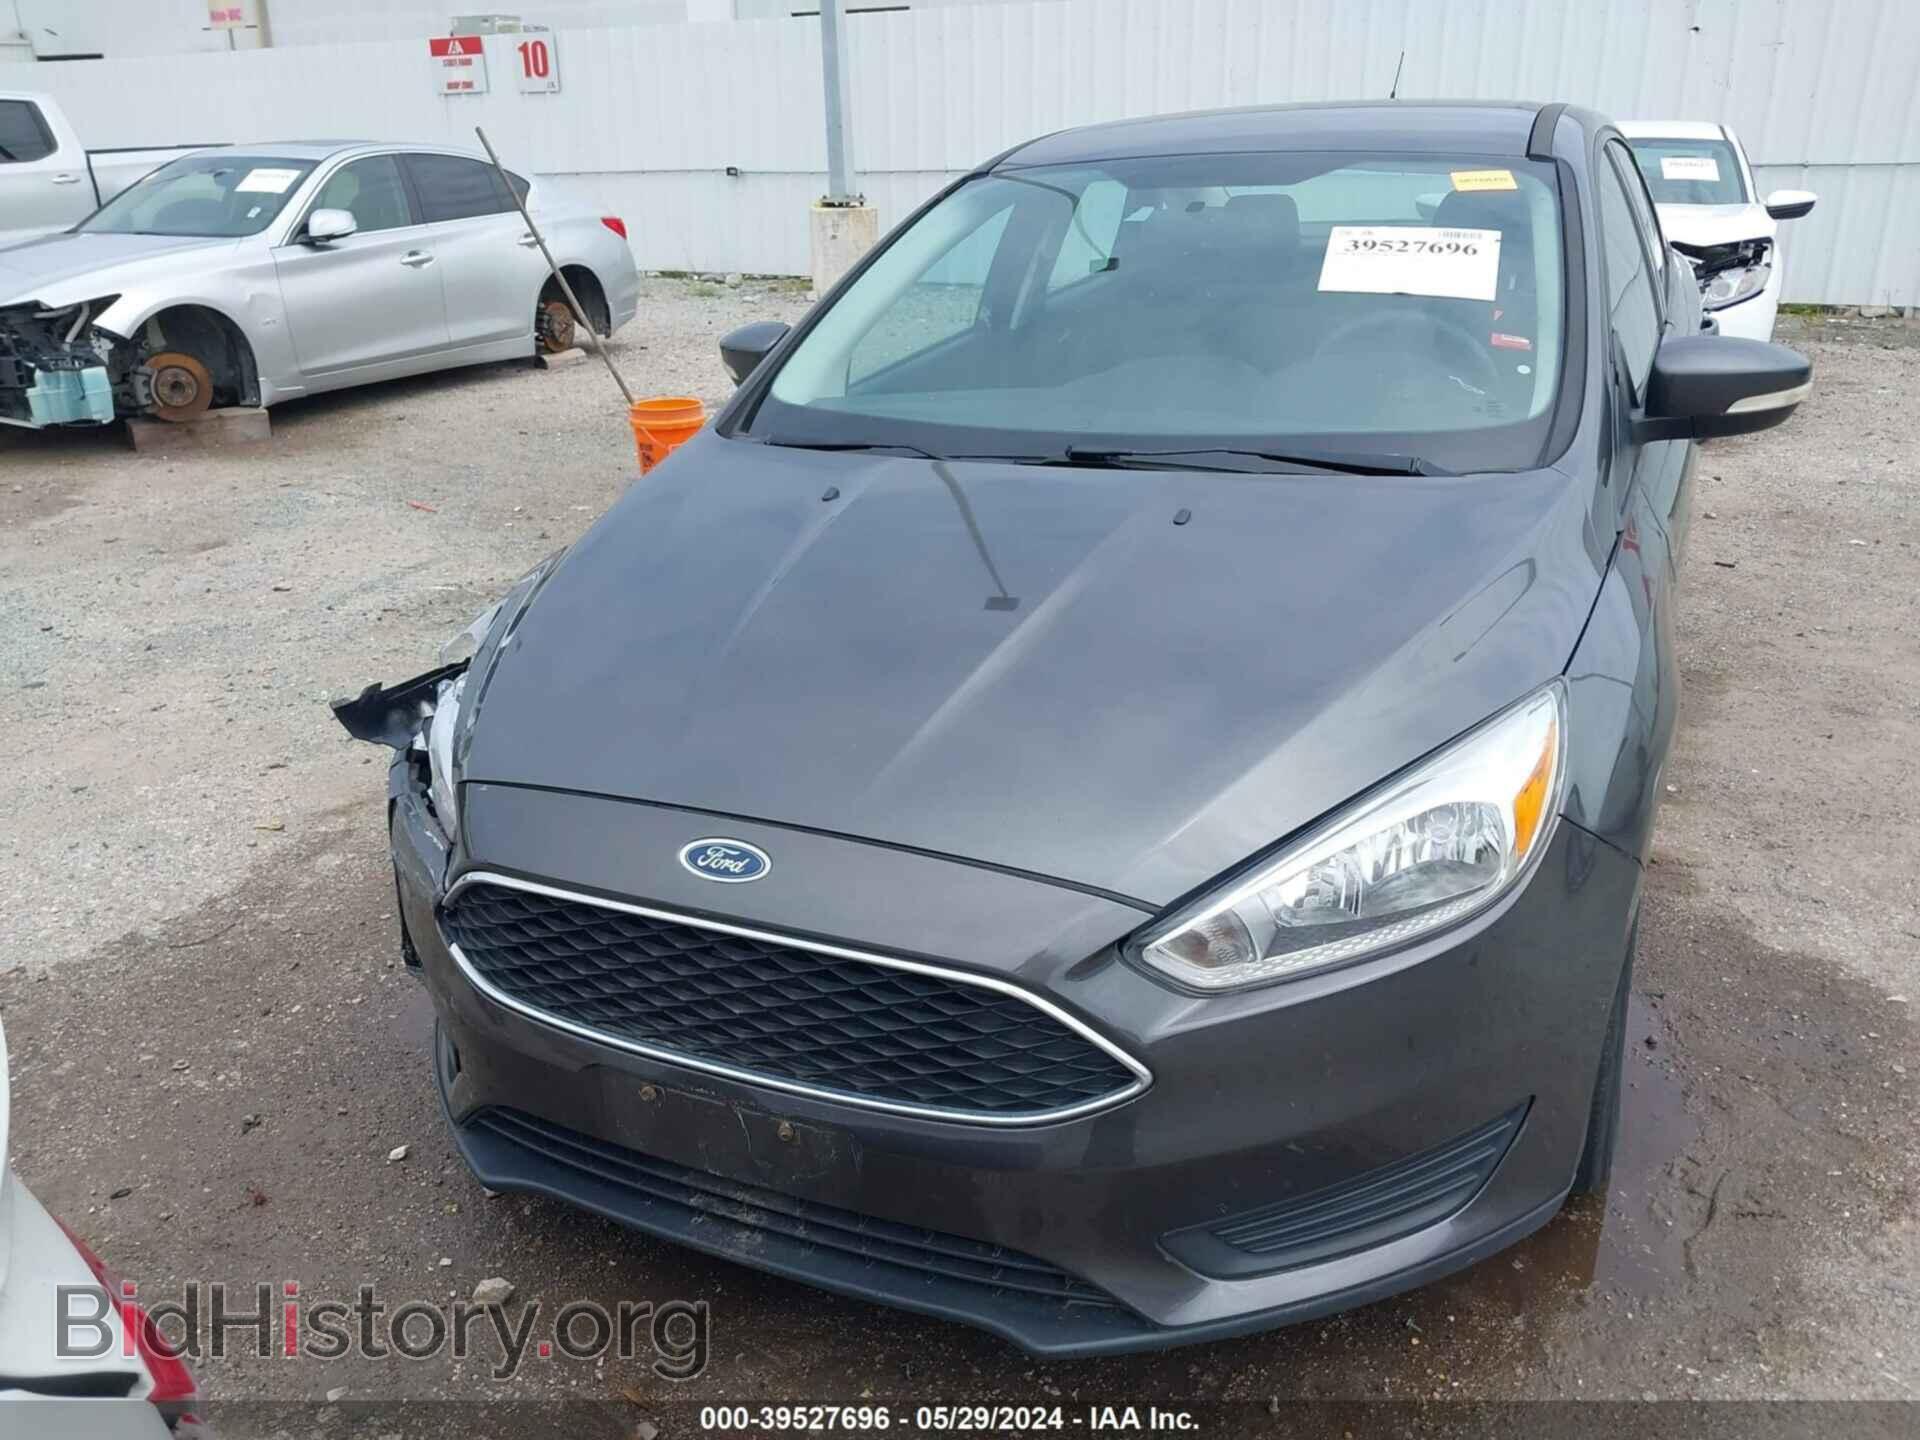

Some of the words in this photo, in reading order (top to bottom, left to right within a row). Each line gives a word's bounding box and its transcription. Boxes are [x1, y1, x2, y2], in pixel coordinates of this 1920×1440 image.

[517, 40, 549, 78] 10
[1344, 238, 1479, 256] 39527696
[697, 845, 751, 873] Ford
